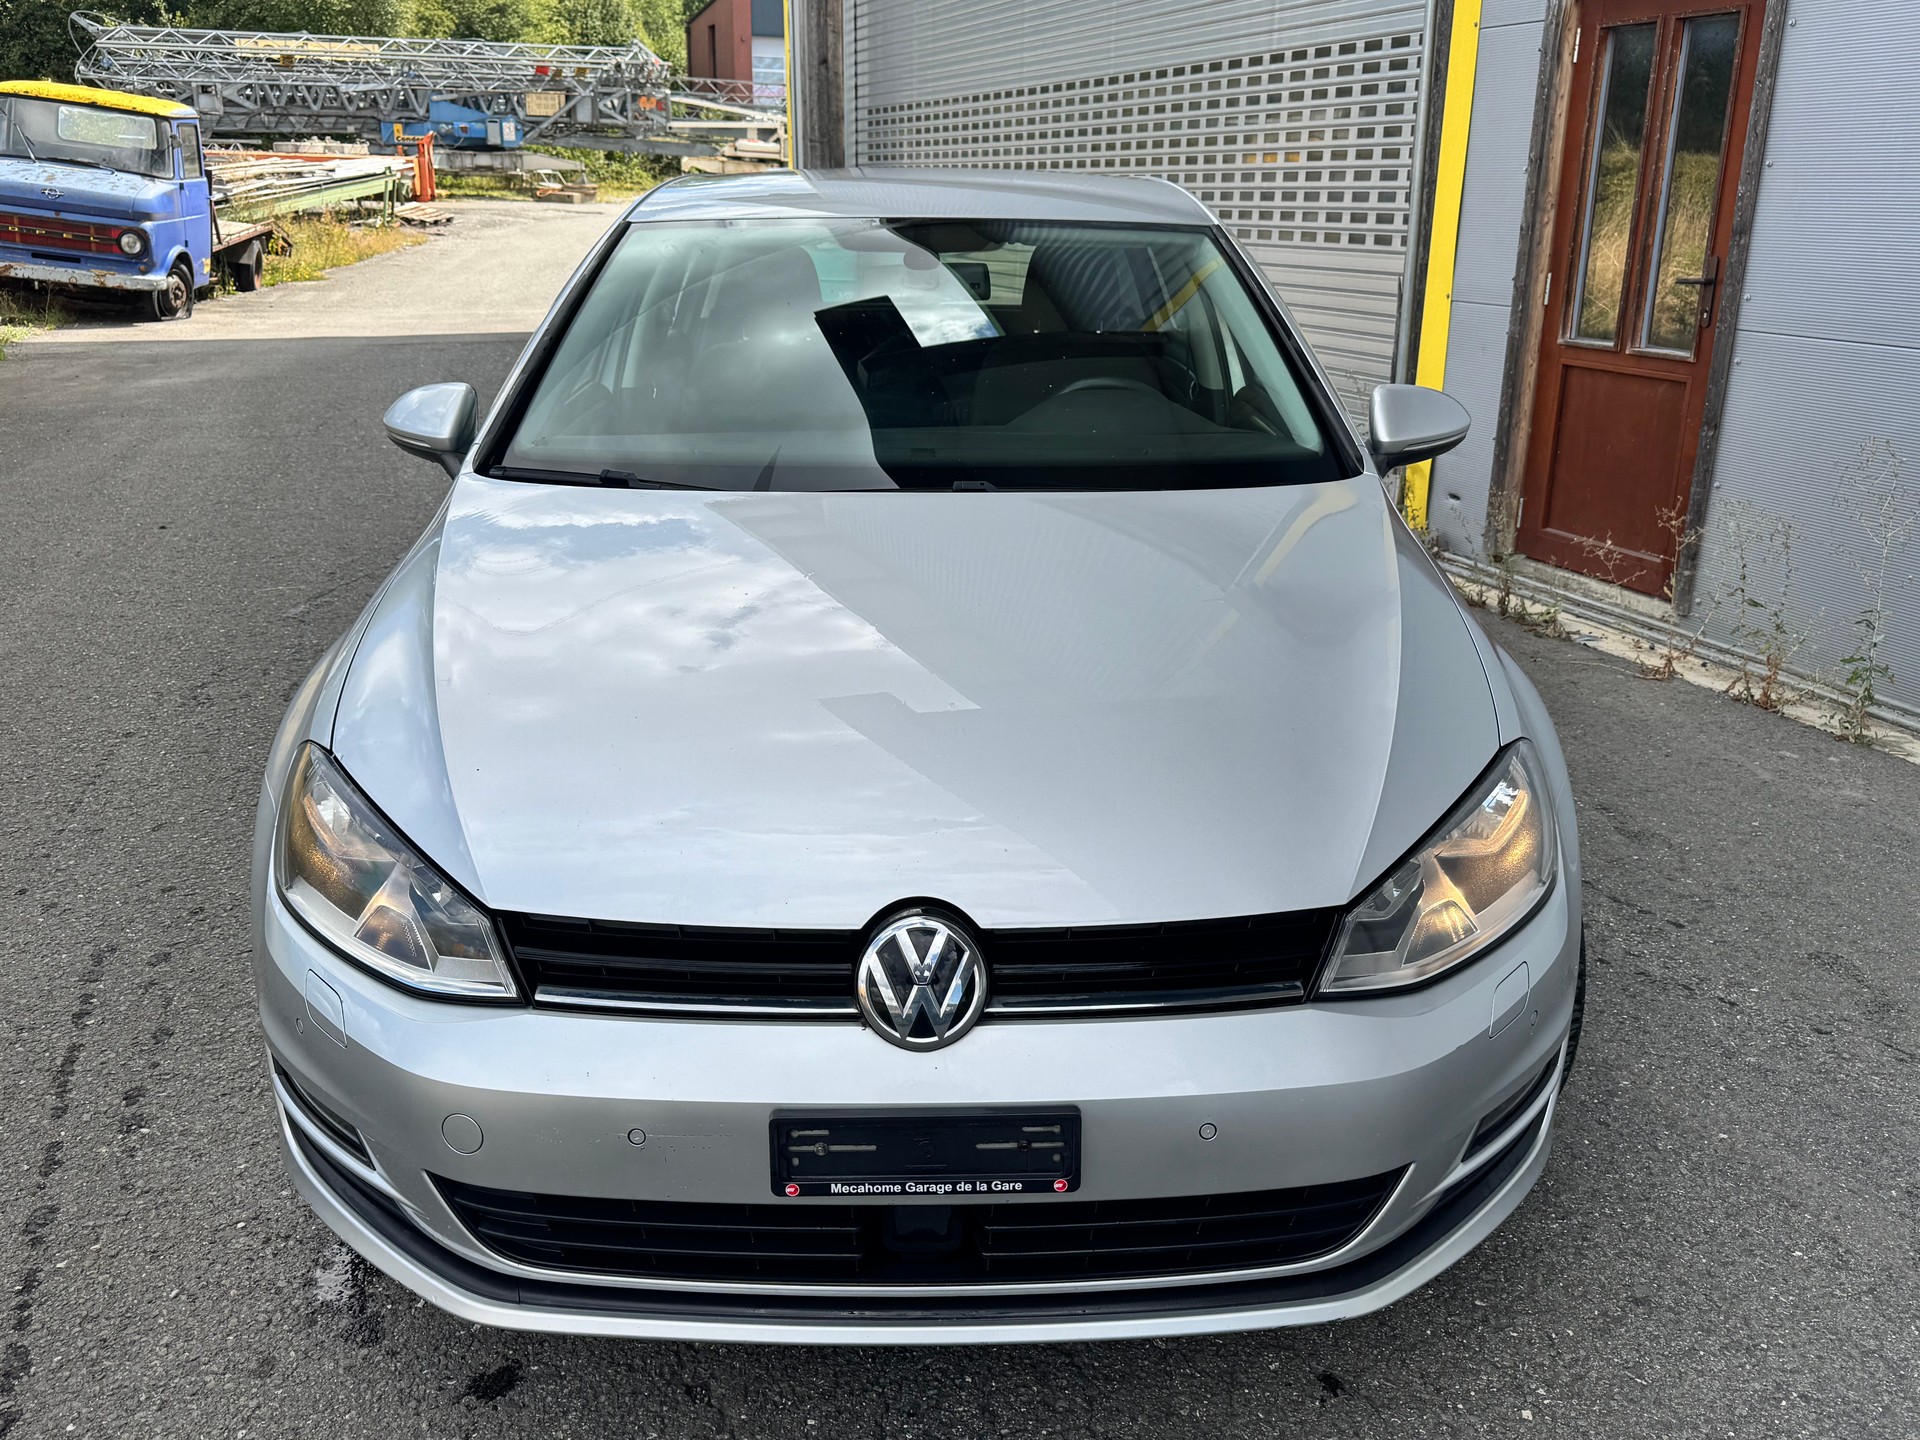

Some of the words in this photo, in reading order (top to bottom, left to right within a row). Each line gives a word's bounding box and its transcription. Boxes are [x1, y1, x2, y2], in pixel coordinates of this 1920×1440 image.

[862, 920, 983, 1047] VW
[830, 1183, 902, 1194] Mecahome
[905, 1182, 953, 1194] Garage
[956, 1181, 973, 1192] de
[976, 1180, 988, 1191] la
[991, 1181, 1023, 1191] Gare
